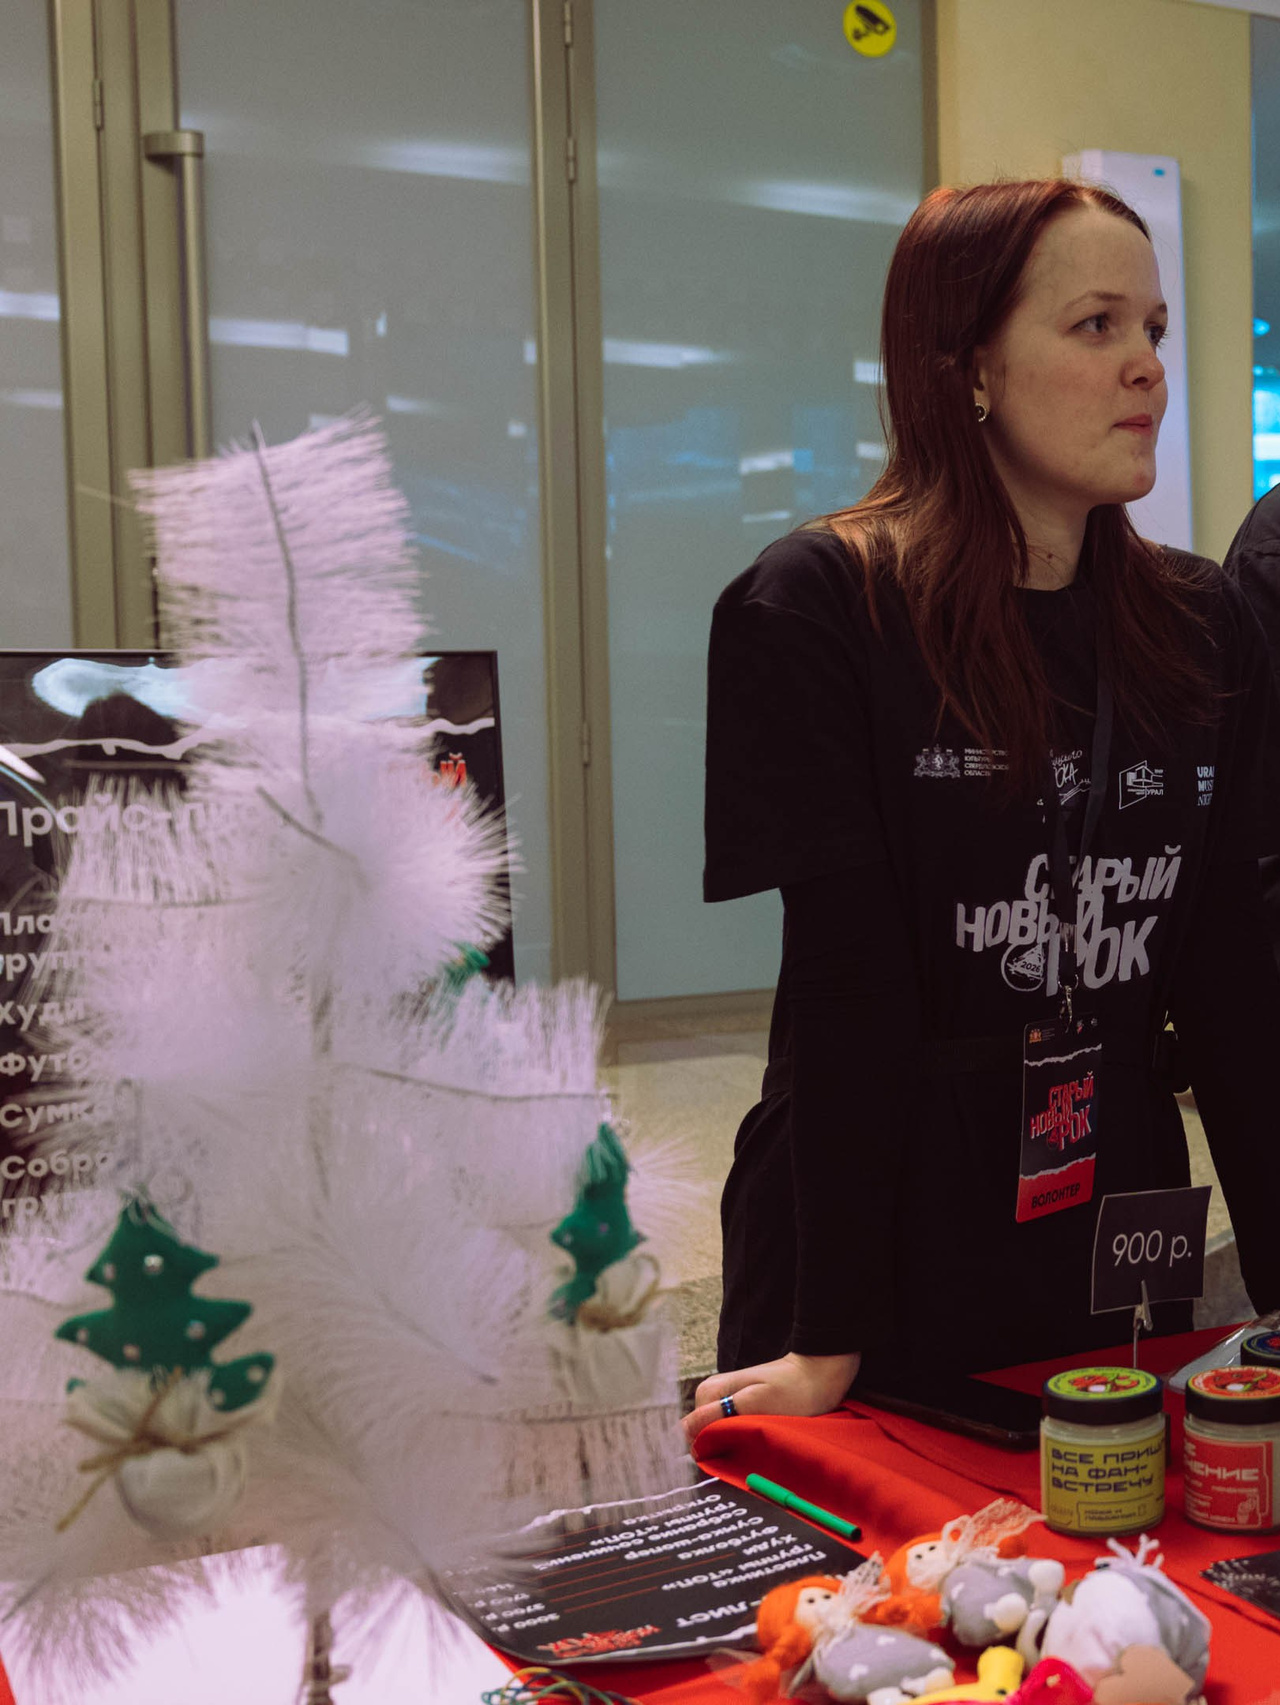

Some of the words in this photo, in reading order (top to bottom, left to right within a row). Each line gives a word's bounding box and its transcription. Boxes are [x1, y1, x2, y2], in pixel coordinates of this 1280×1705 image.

[1196, 765, 1215, 779] URA
[1197, 779, 1214, 792] MUS
[1024, 844, 1182, 904] САРЫЙ
[1020, 960, 1041, 974] 2026
[1049, 1070, 1094, 1105] СТАРЫЙ
[1030, 1099, 1073, 1139] НОВЫЙ
[1057, 1105, 1092, 1151] РОК
[1031, 1183, 1081, 1210] ВОЛОНТЕР
[1112, 1229, 1162, 1267] 900
[1168, 1231, 1193, 1268] р.
[1051, 1447, 1094, 1464] ВСЕ
[1051, 1462, 1079, 1478] НА
[1051, 1473, 1154, 1494] ВСТРЕЧУ
[647, 1508, 748, 1542] Собрание
[664, 1501, 737, 1528] группы
[624, 1516, 765, 1561] Сумка-шопер
[677, 1525, 780, 1560] Футболка
[742, 1533, 799, 1556] Худи
[711, 1550, 827, 1589] Пластинка
[676, 1599, 762, 1629] -лист
